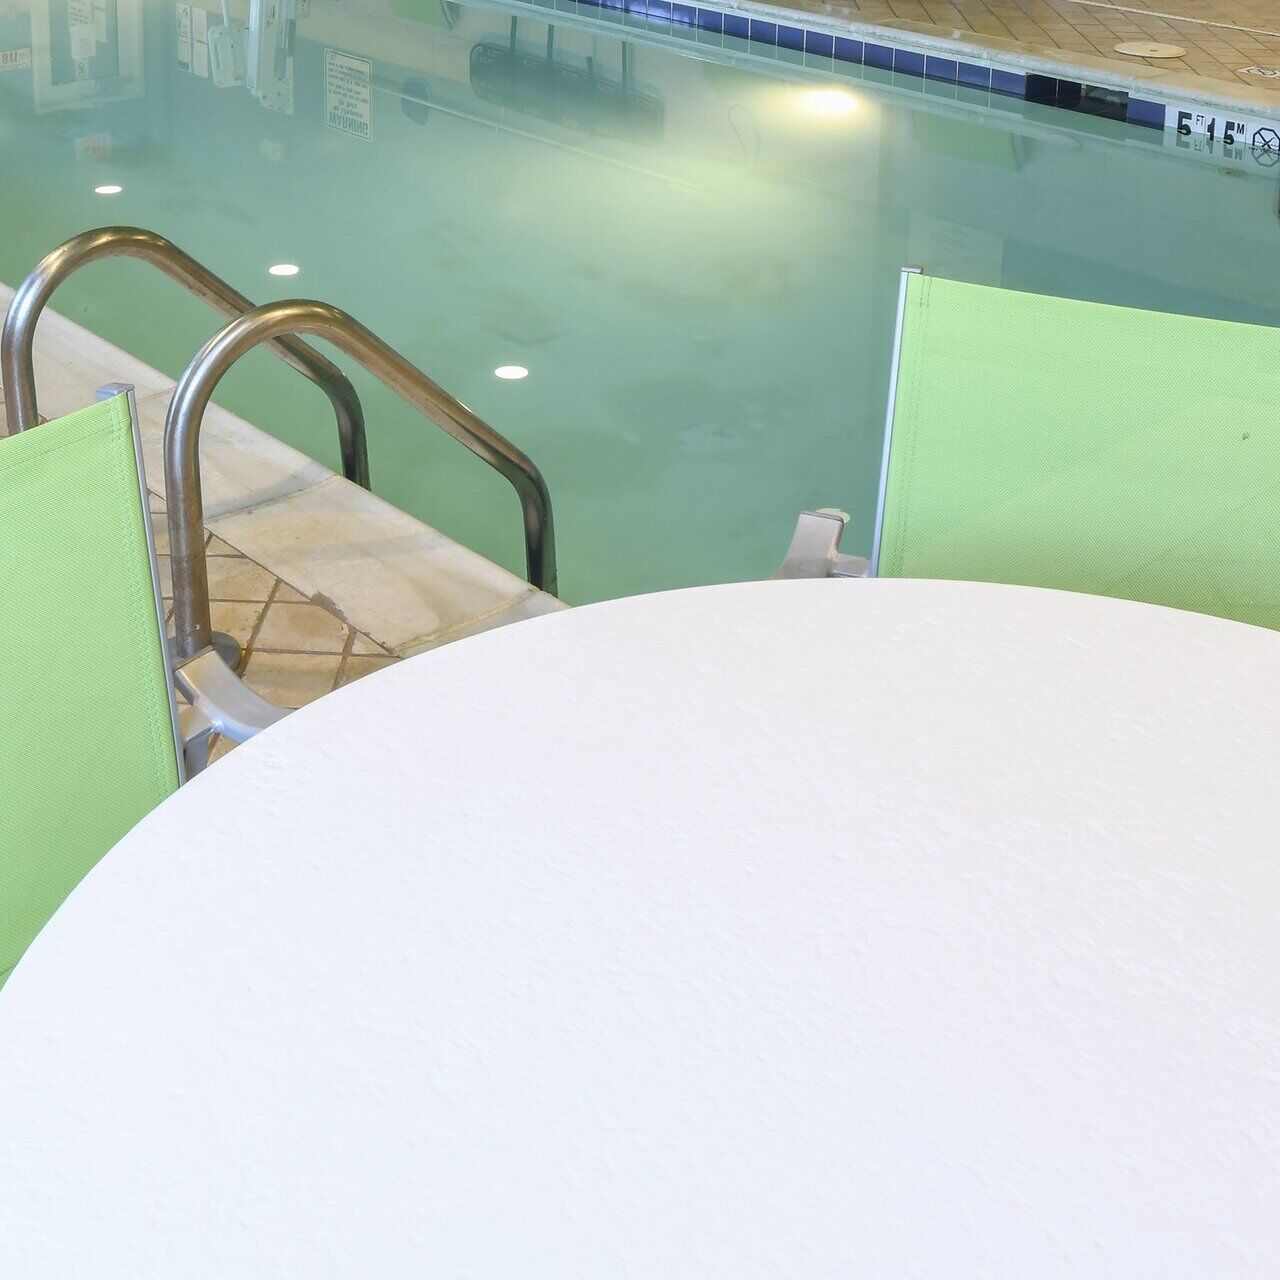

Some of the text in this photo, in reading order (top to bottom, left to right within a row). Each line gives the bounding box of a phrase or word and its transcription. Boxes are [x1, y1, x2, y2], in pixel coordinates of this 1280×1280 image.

[1177, 110, 1192, 136] 5
[1196, 114, 1205, 127] FT
[1237, 123, 1245, 135] M
